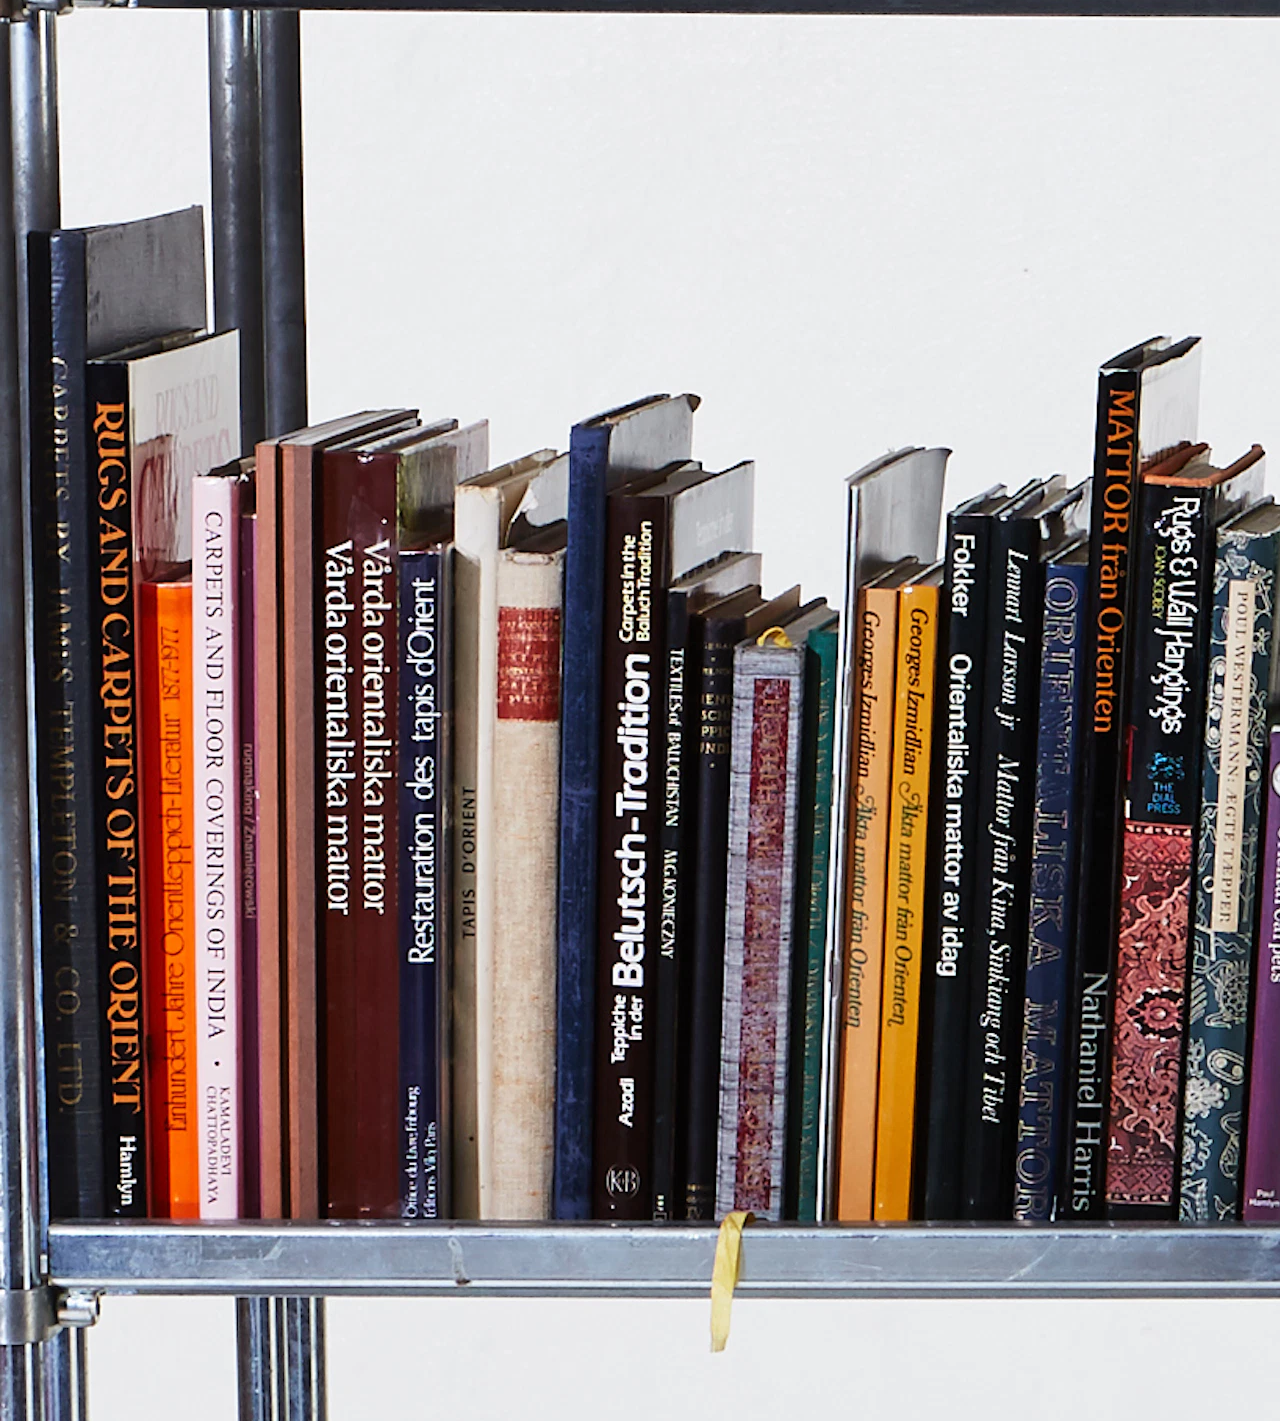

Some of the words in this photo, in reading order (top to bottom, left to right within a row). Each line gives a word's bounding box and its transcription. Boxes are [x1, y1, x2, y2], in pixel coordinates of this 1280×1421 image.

[93, 400, 129, 510] RUGS
[1101, 387, 1138, 535] MATTOR
[98, 517, 132, 605] AND
[361, 539, 393, 627] Vårda
[408, 578, 441, 675] d'Orient
[1092, 604, 1125, 733] Orienten
[99, 613, 137, 797] CARPETS
[361, 632, 393, 806] orientaliska
[410, 683, 439, 742] tapis
[408, 757, 437, 803] des
[105, 805, 136, 861] OF
[362, 812, 392, 915] mattor
[106, 868, 138, 951] THE
[408, 812, 437, 963] Restauration
[107, 958, 142, 1115] ORIENT
[1074, 971, 1107, 1112] Nathaniel
[613, 1076, 637, 1127] Azadi
[114, 1135, 138, 1206] Hamlyn
[1071, 1120, 1102, 1213] Harris
